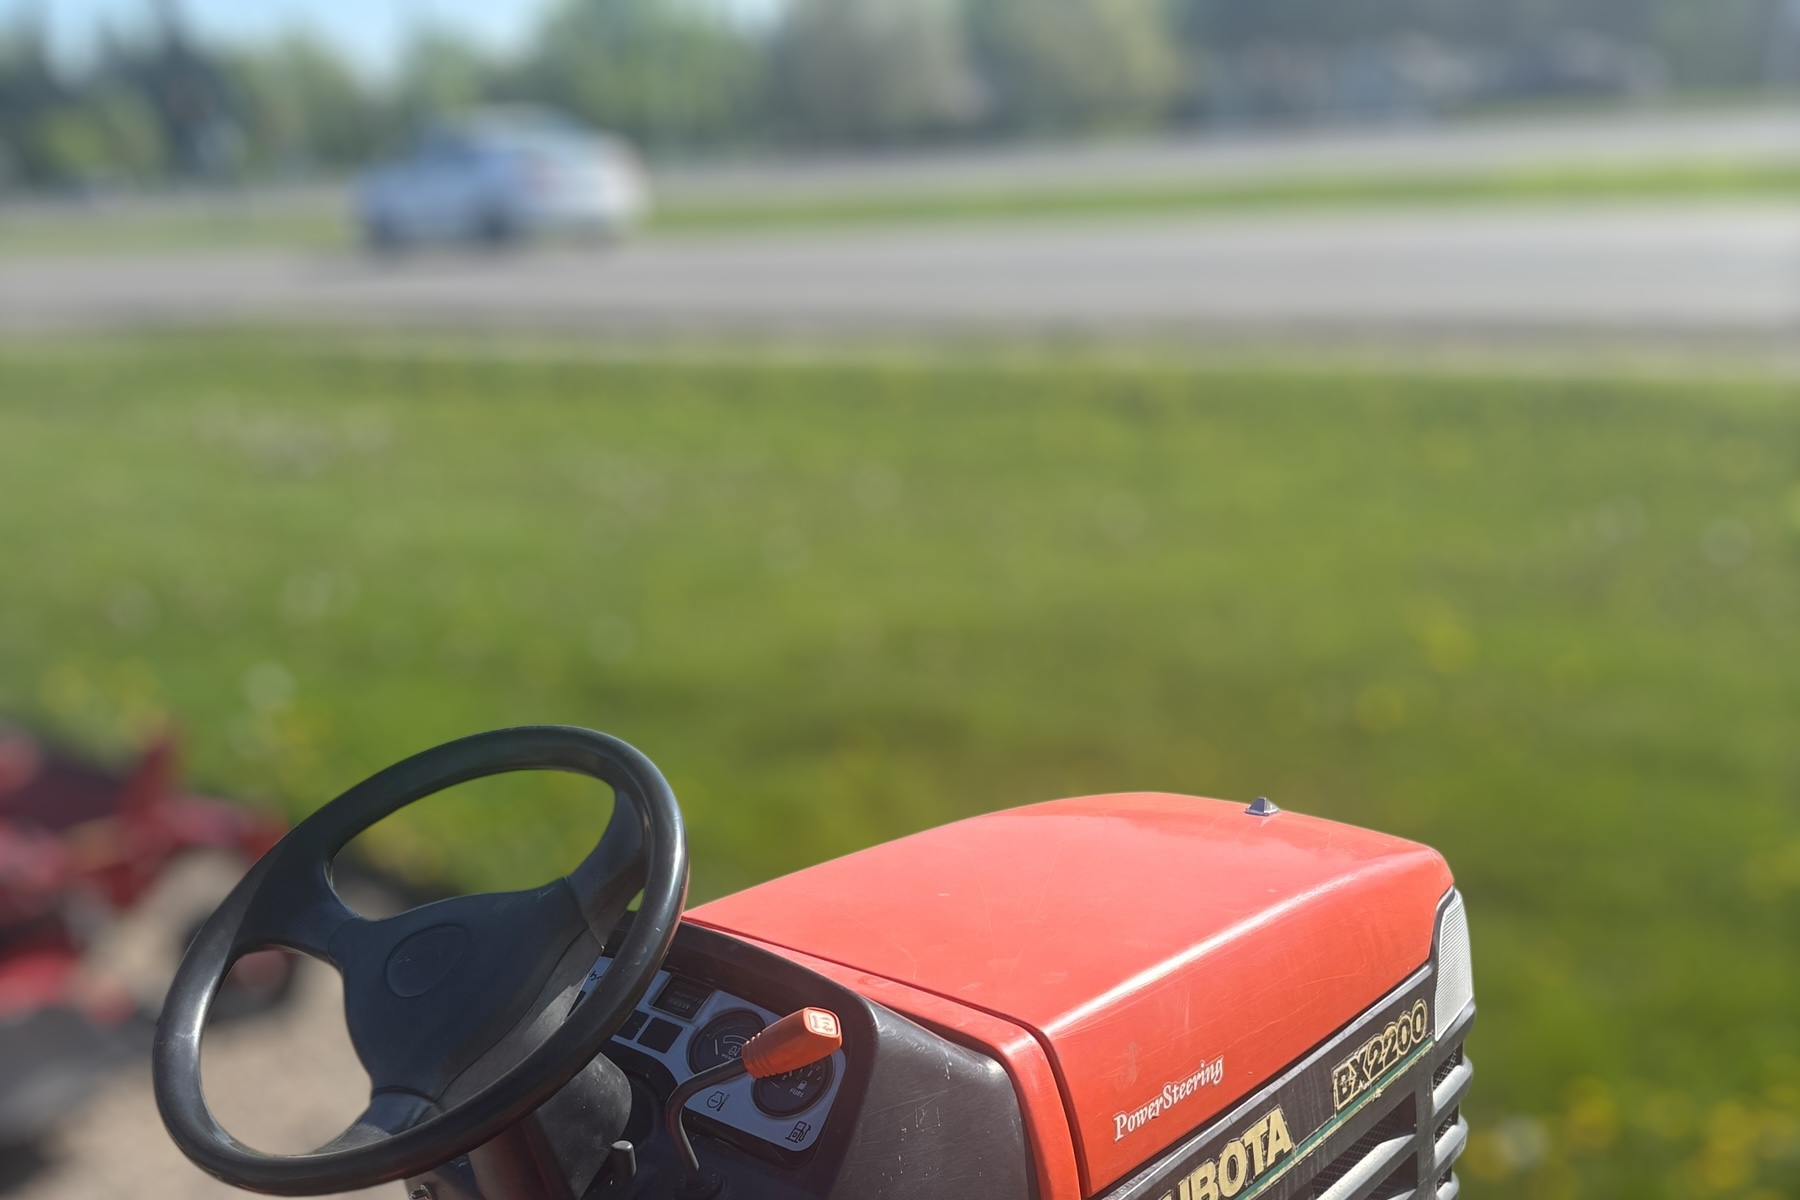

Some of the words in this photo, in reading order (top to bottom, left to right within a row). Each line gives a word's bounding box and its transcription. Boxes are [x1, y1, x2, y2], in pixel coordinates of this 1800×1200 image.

[789, 1087, 804, 1098] FUEL
[1333, 999, 1428, 1111] BX2200
[1113, 1056, 1225, 1142] PowerSteering
